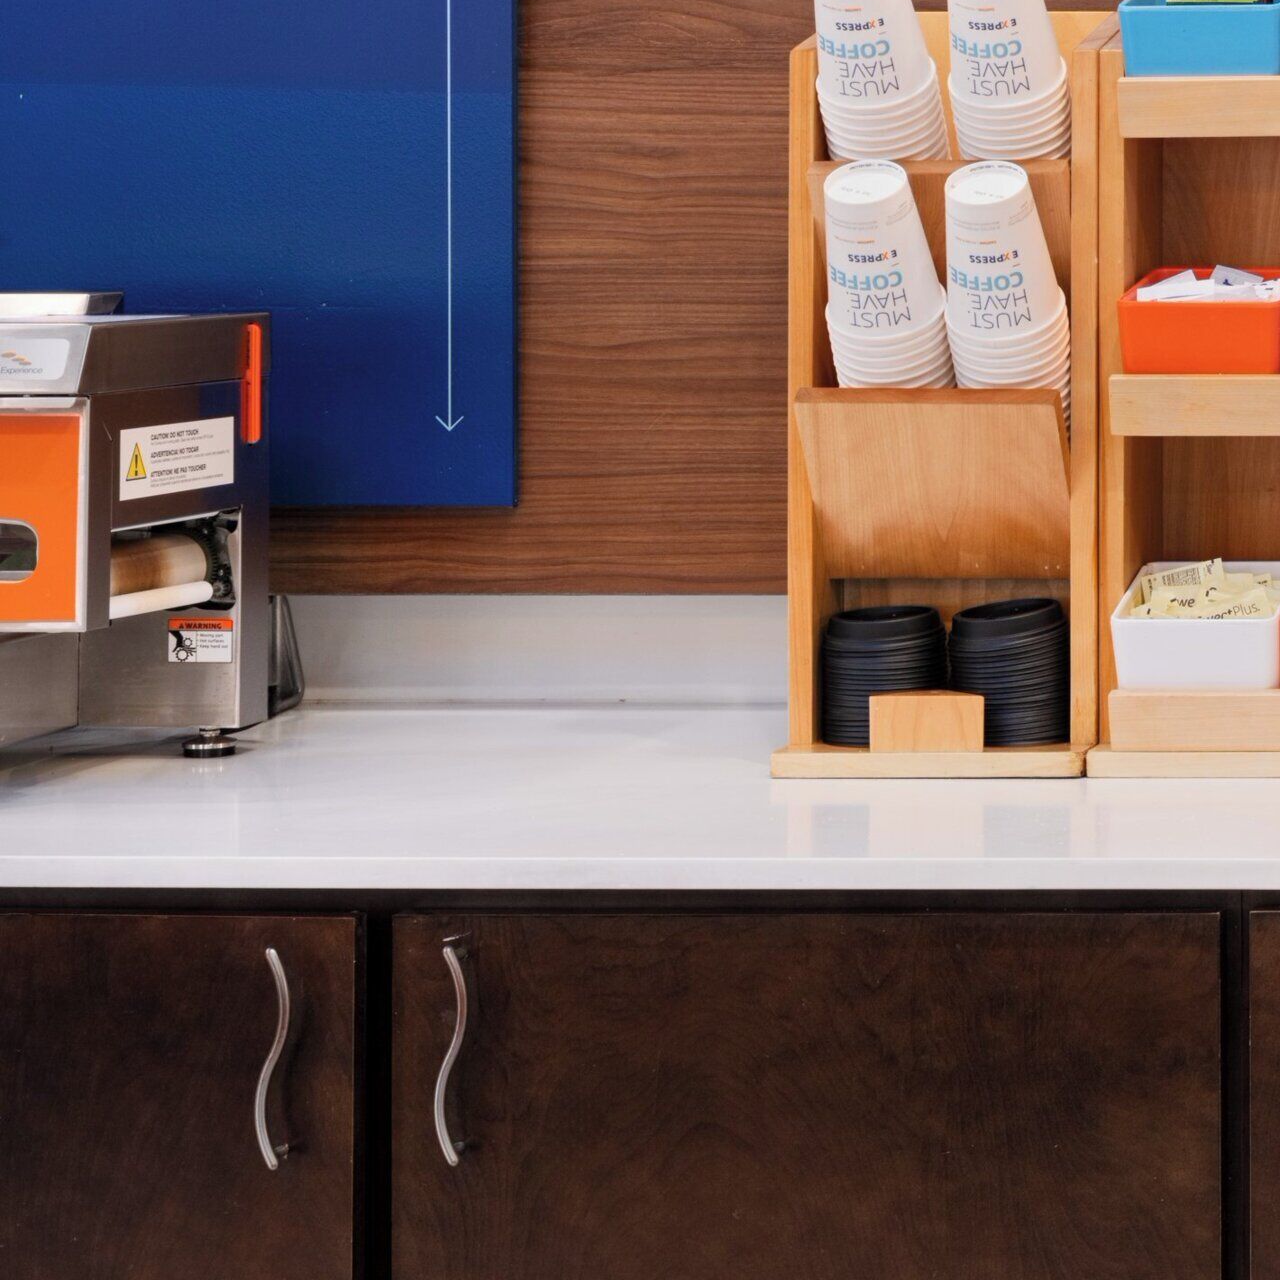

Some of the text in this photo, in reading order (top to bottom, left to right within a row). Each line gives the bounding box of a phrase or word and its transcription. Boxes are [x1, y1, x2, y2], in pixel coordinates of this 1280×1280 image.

[836, 18, 885, 32] EXPRESS
[968, 18, 1017, 31] EXPRESS
[835, 57, 895, 78] HAVE.
[966, 57, 1026, 78] HAVE.
[848, 249, 897, 263] EXPRESS
[969, 250, 1018, 264] EXPRESS
[846, 288, 908, 310] HAVE.
[967, 288, 1028, 310] HAVE.
[184, 622, 222, 630] WARNING
